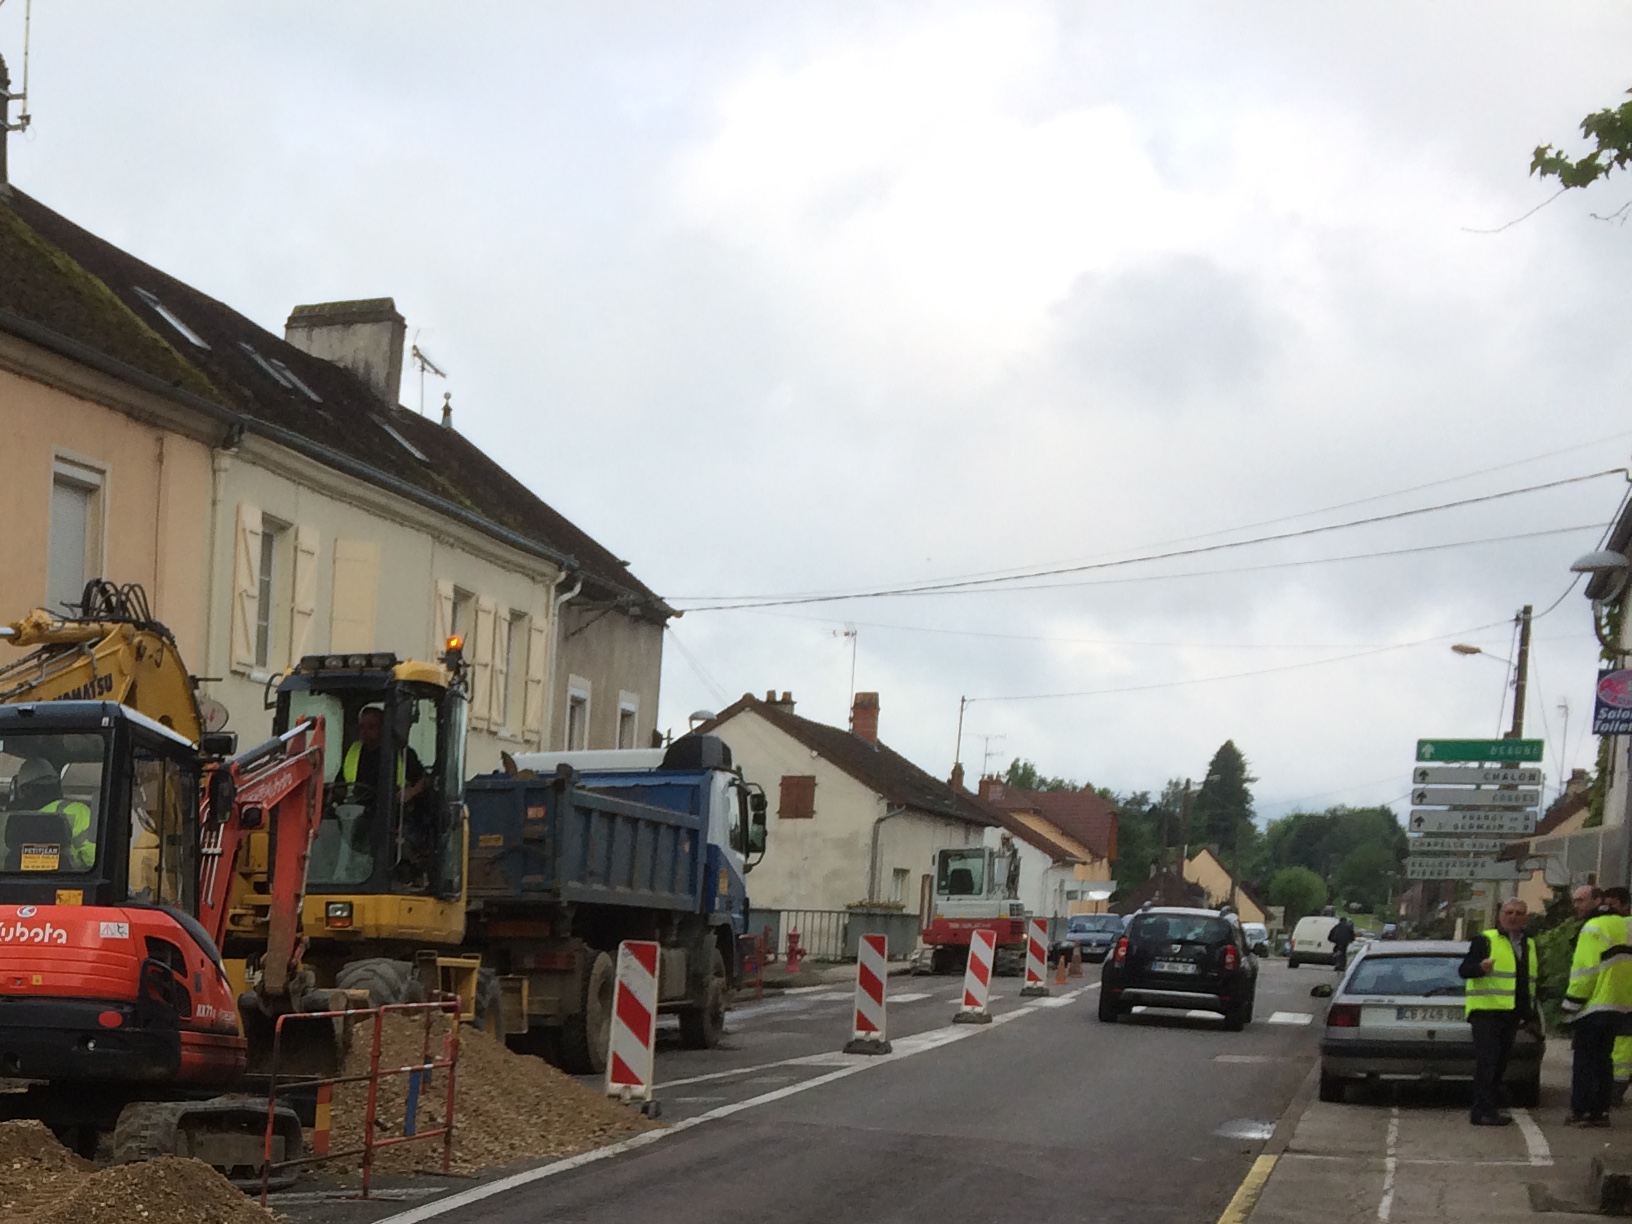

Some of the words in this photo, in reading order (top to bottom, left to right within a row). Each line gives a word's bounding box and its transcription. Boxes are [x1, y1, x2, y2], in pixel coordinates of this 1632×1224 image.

[53, 673, 113, 700] OMATSU
[1598, 707, 1632, 720] Salo
[1483, 772, 1537, 781] CHALON
